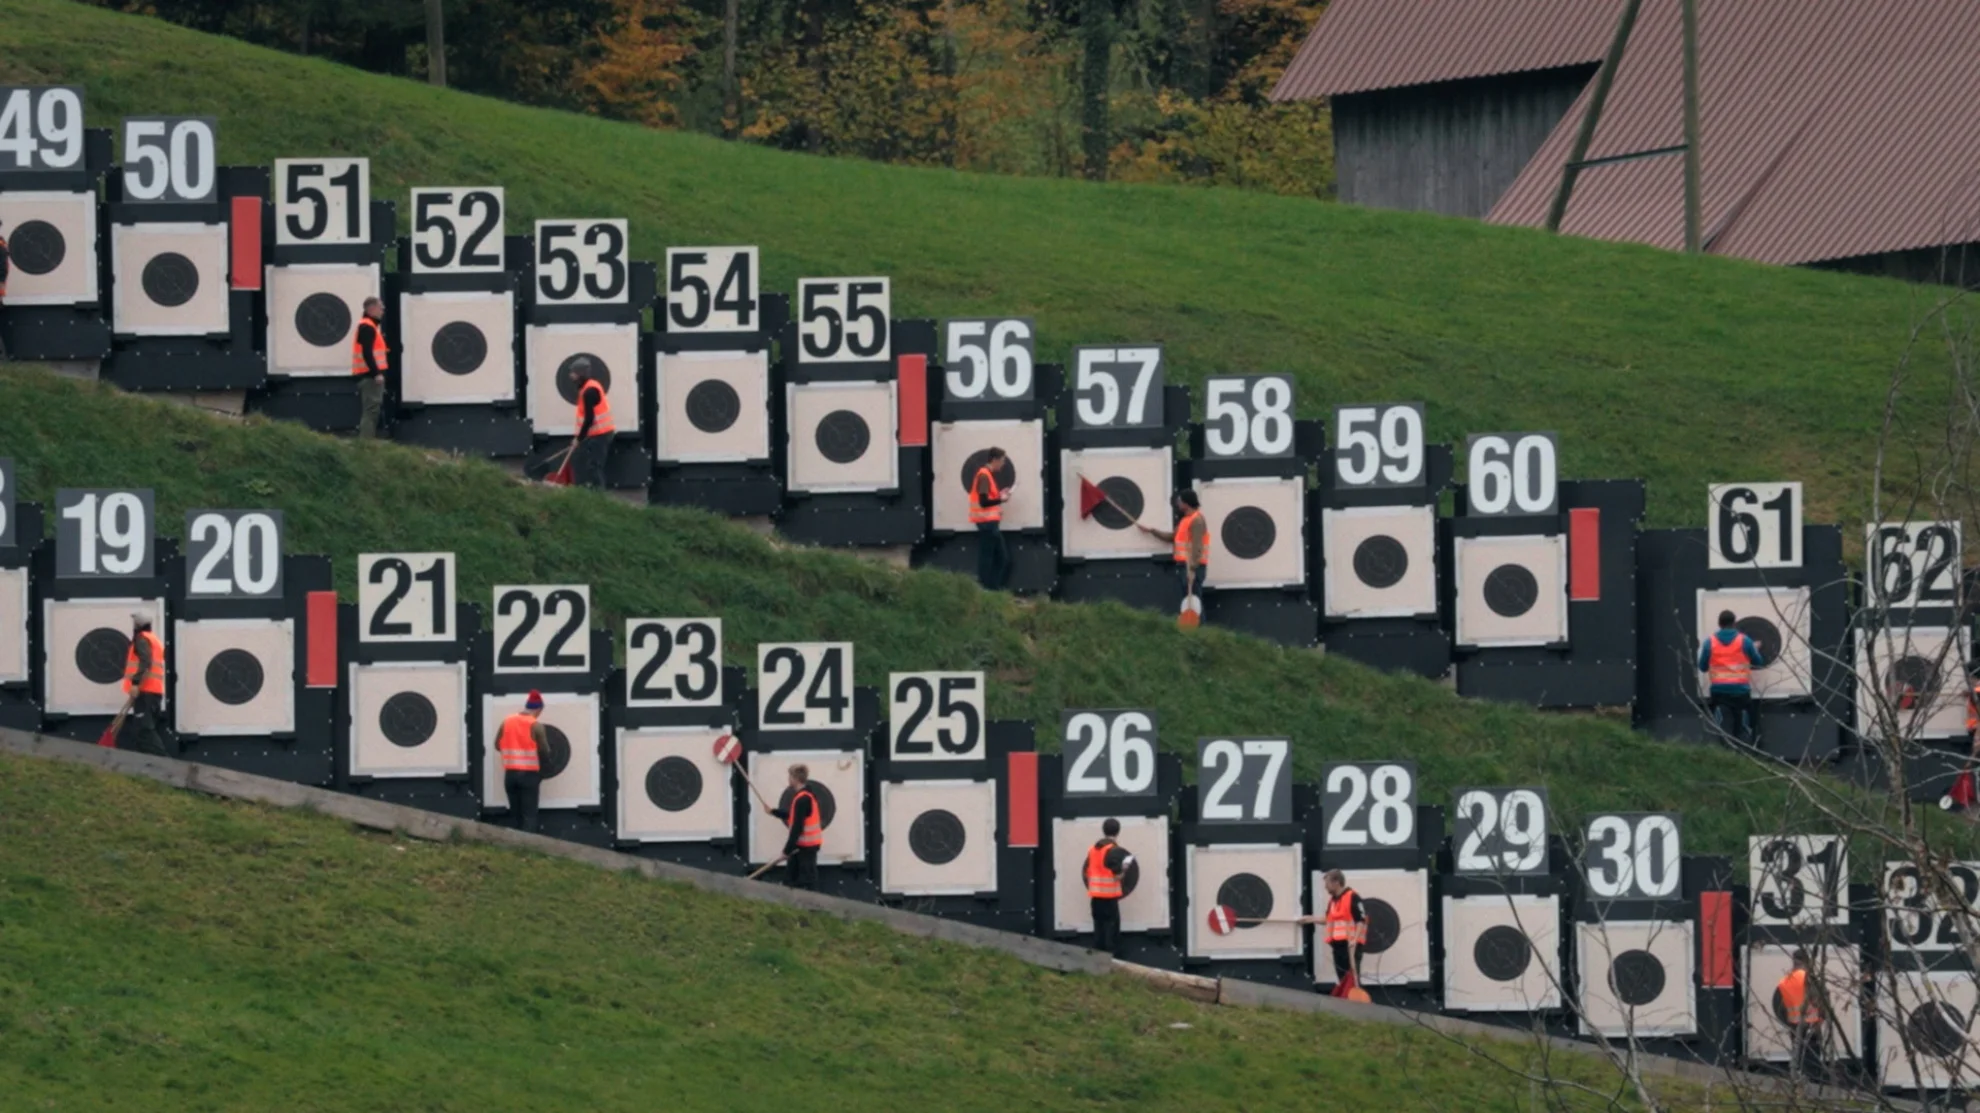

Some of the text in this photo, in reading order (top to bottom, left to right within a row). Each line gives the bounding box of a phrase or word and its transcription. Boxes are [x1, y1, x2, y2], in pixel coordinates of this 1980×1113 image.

[0, 88, 83, 168] 49
[124, 119, 214, 200] 50
[286, 163, 361, 240] 51
[415, 192, 500, 268] 52
[539, 224, 624, 300] 53
[669, 252, 756, 328] 54
[801, 282, 887, 358] 55
[946, 319, 1032, 399] 56
[1076, 348, 1160, 426] 57
[1205, 375, 1293, 456] 58
[1336, 405, 1424, 485] 59
[1468, 434, 1557, 515] 60
[62, 492, 146, 574] 19
[190, 513, 279, 595] 20
[1718, 487, 1792, 563] 61
[1871, 525, 1958, 602] 62
[368, 558, 446, 636] 21
[497, 590, 586, 668] 22
[630, 622, 719, 701] 23
[762, 647, 849, 724] 24
[894, 677, 980, 754] 25
[1066, 712, 1155, 793] 26
[1202, 740, 1288, 819] 27
[1326, 764, 1413, 846] 28
[1457, 789, 1546, 871] 29
[1587, 815, 1680, 897] 30
[1760, 840, 1839, 919] 31
[1888, 866, 1980, 945] 32
